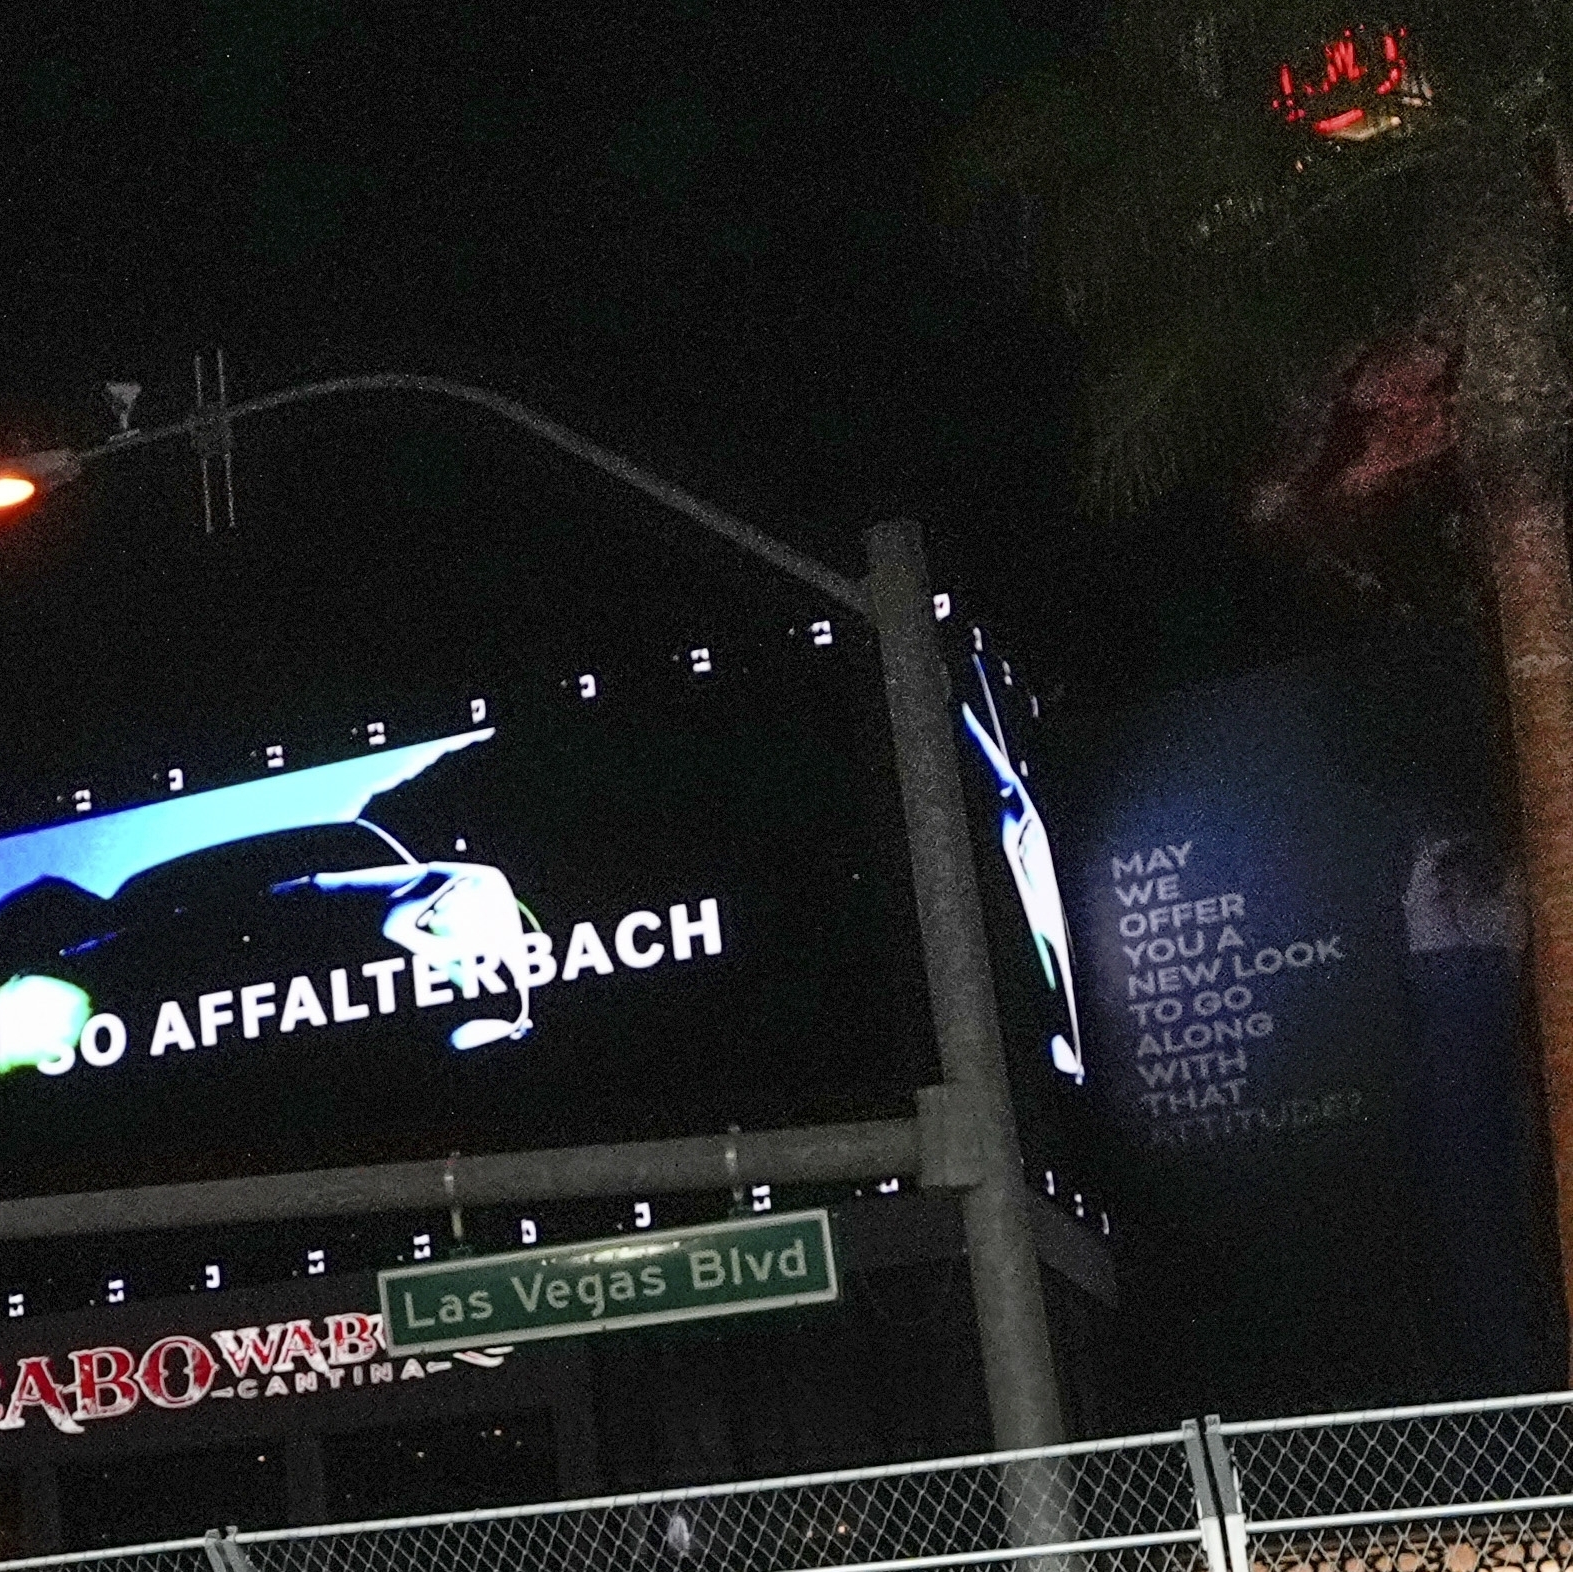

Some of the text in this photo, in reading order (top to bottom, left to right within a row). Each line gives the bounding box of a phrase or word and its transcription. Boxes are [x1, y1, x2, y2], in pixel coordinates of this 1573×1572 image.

[1112, 841, 1192, 880] MAY
[1115, 874, 1180, 907] WE
[1119, 893, 1245, 937] OFFER
[1123, 924, 1245, 968] YOU A
[1128, 935, 1347, 998] NEW LOOK
[150, 898, 723, 1057] AFFALTERBACH
[1129, 985, 1252, 1026] TO GO
[1137, 1011, 1274, 1057] ALONG
[1138, 1049, 1247, 1087] WITH
[1141, 1077, 1247, 1117] THAT
[404, 1239, 808, 1329] Las Vegas Blvd
[239, 1358, 429, 1400] CANTINA
